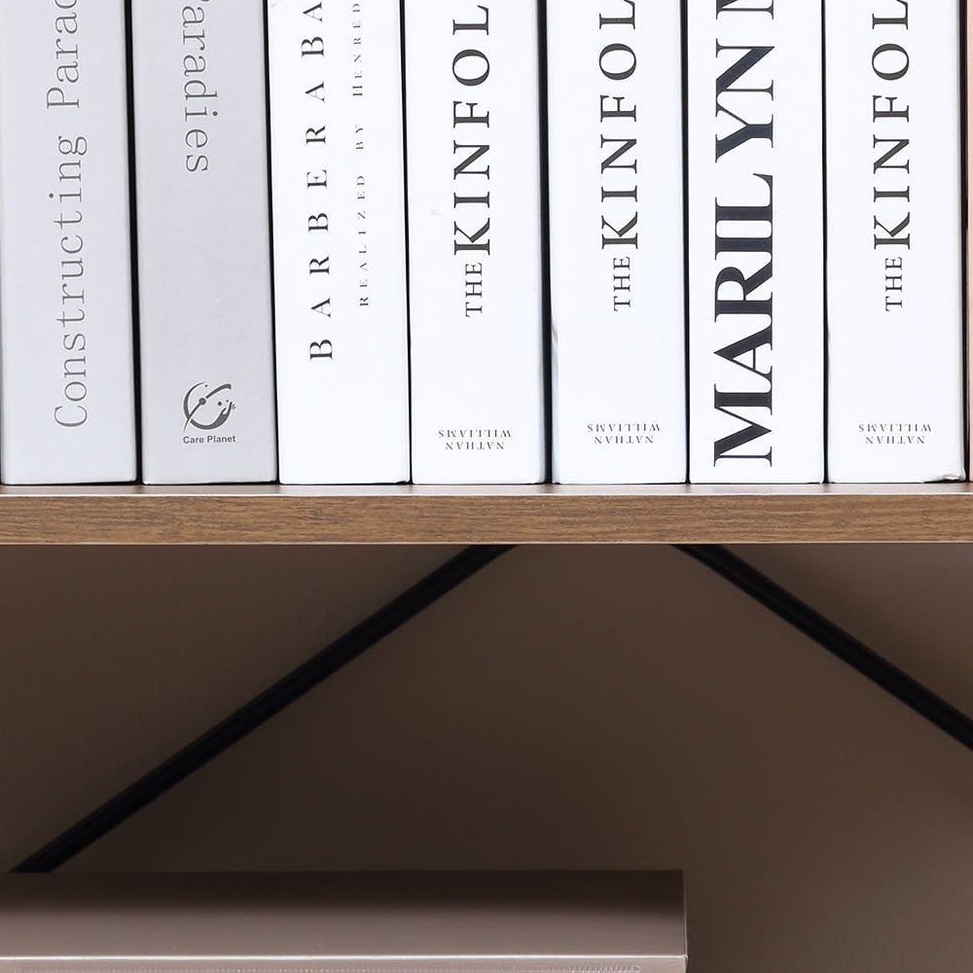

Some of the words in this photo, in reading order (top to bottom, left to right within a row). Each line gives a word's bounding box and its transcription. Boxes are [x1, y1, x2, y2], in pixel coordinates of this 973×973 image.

[354, 124, 365, 150] BY
[48, 135, 88, 428] Constructing
[612, 255, 632, 313] THE
[884, 256, 904, 313] THE
[464, 261, 484, 318] THE
[586, 422, 661, 433] WILLIAMS
[858, 423, 932, 433] WILLIAMS
[182, 434, 205, 445] Care
[206, 433, 237, 445] Planet
[437, 428, 512, 439] WILLIAMS
[593, 434, 654, 445] NATHAN
[865, 435, 925, 445] NATHAN
[445, 440, 505, 451] NATHAN
